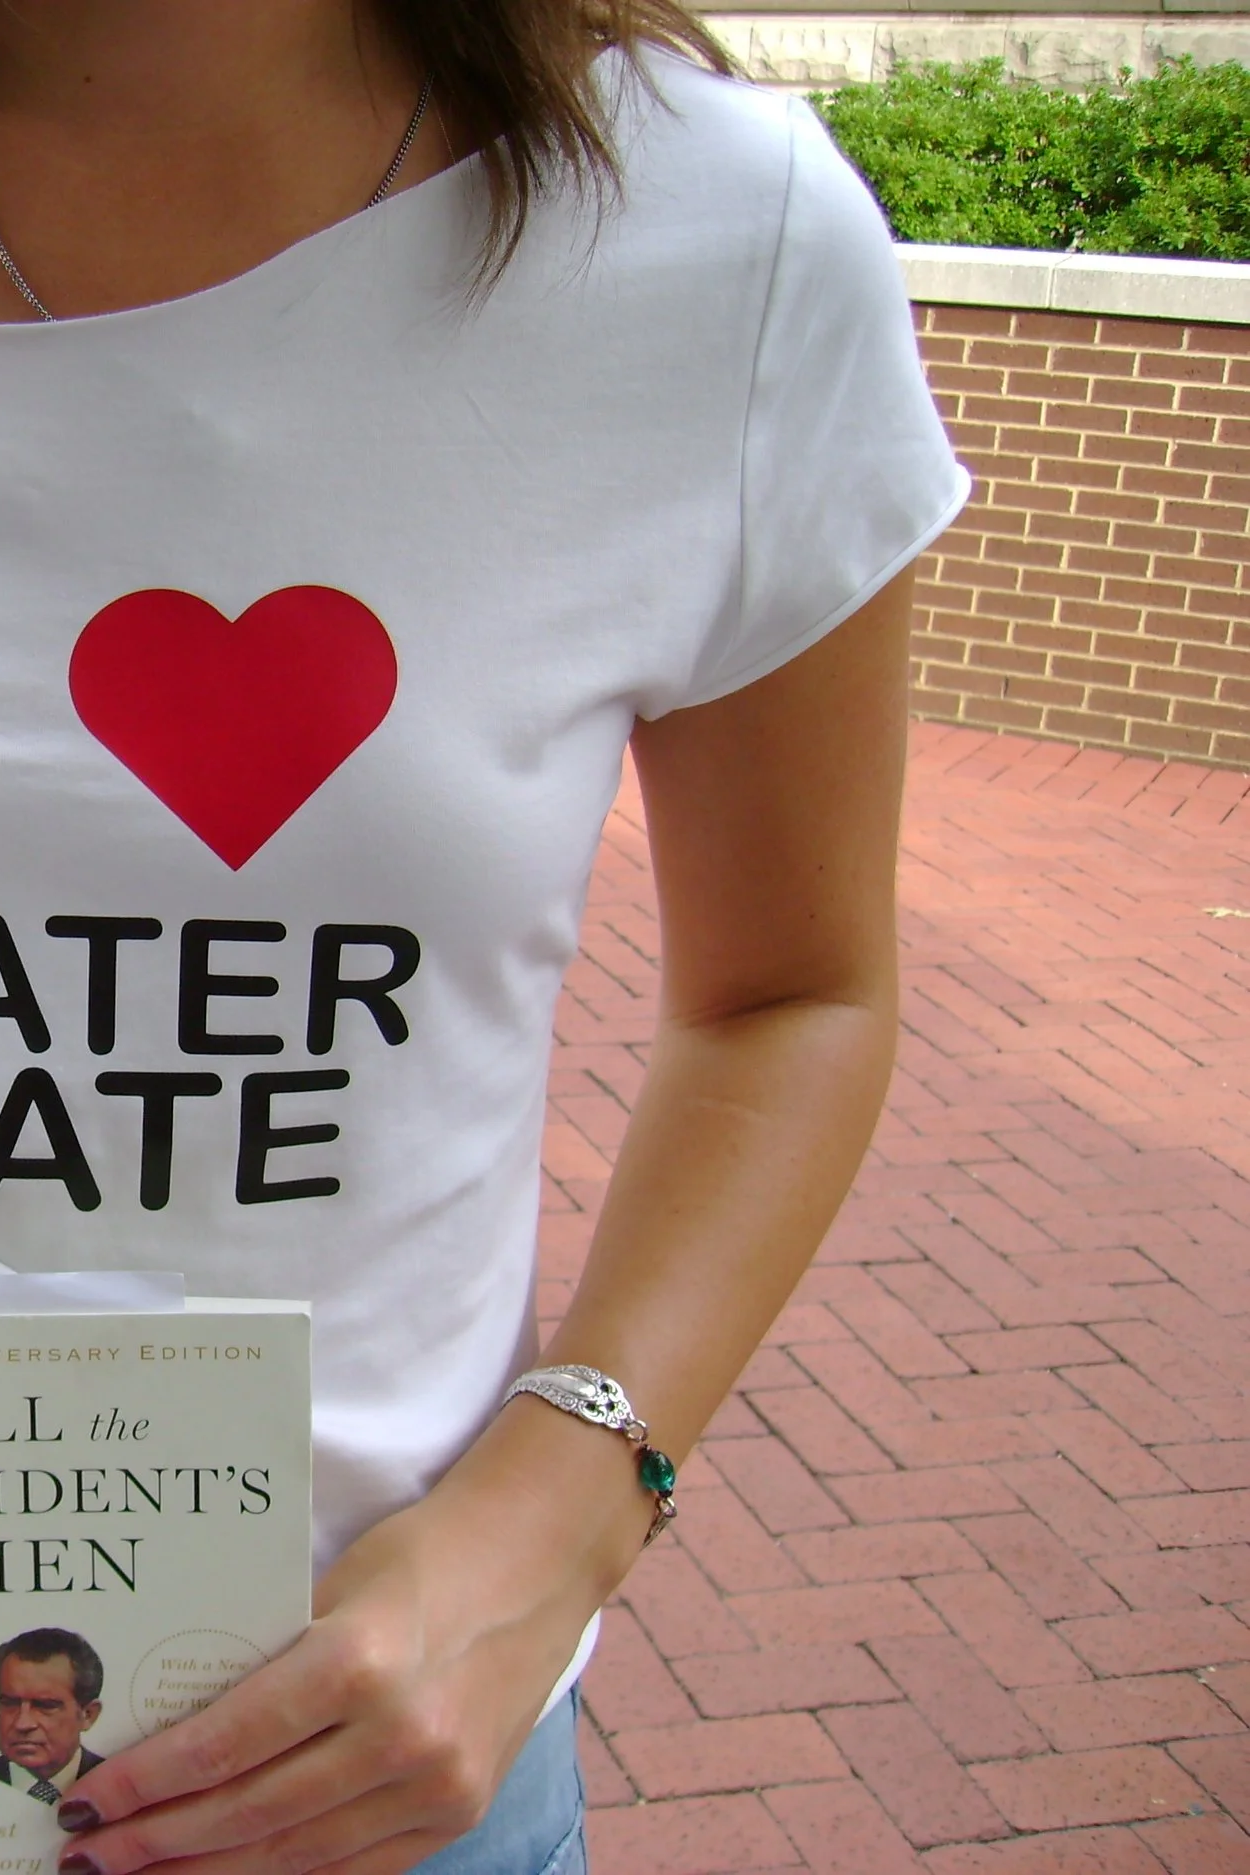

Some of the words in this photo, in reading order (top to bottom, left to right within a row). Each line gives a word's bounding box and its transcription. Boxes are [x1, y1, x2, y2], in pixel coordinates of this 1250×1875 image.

[140, 1344, 262, 1361] EDITION
[90, 1407, 150, 1442] the
[161, 1658, 197, 1671] With
[202, 1662, 212, 1671] a
[157, 1678, 231, 1692] Foreword
[144, 1697, 185, 1710] What
